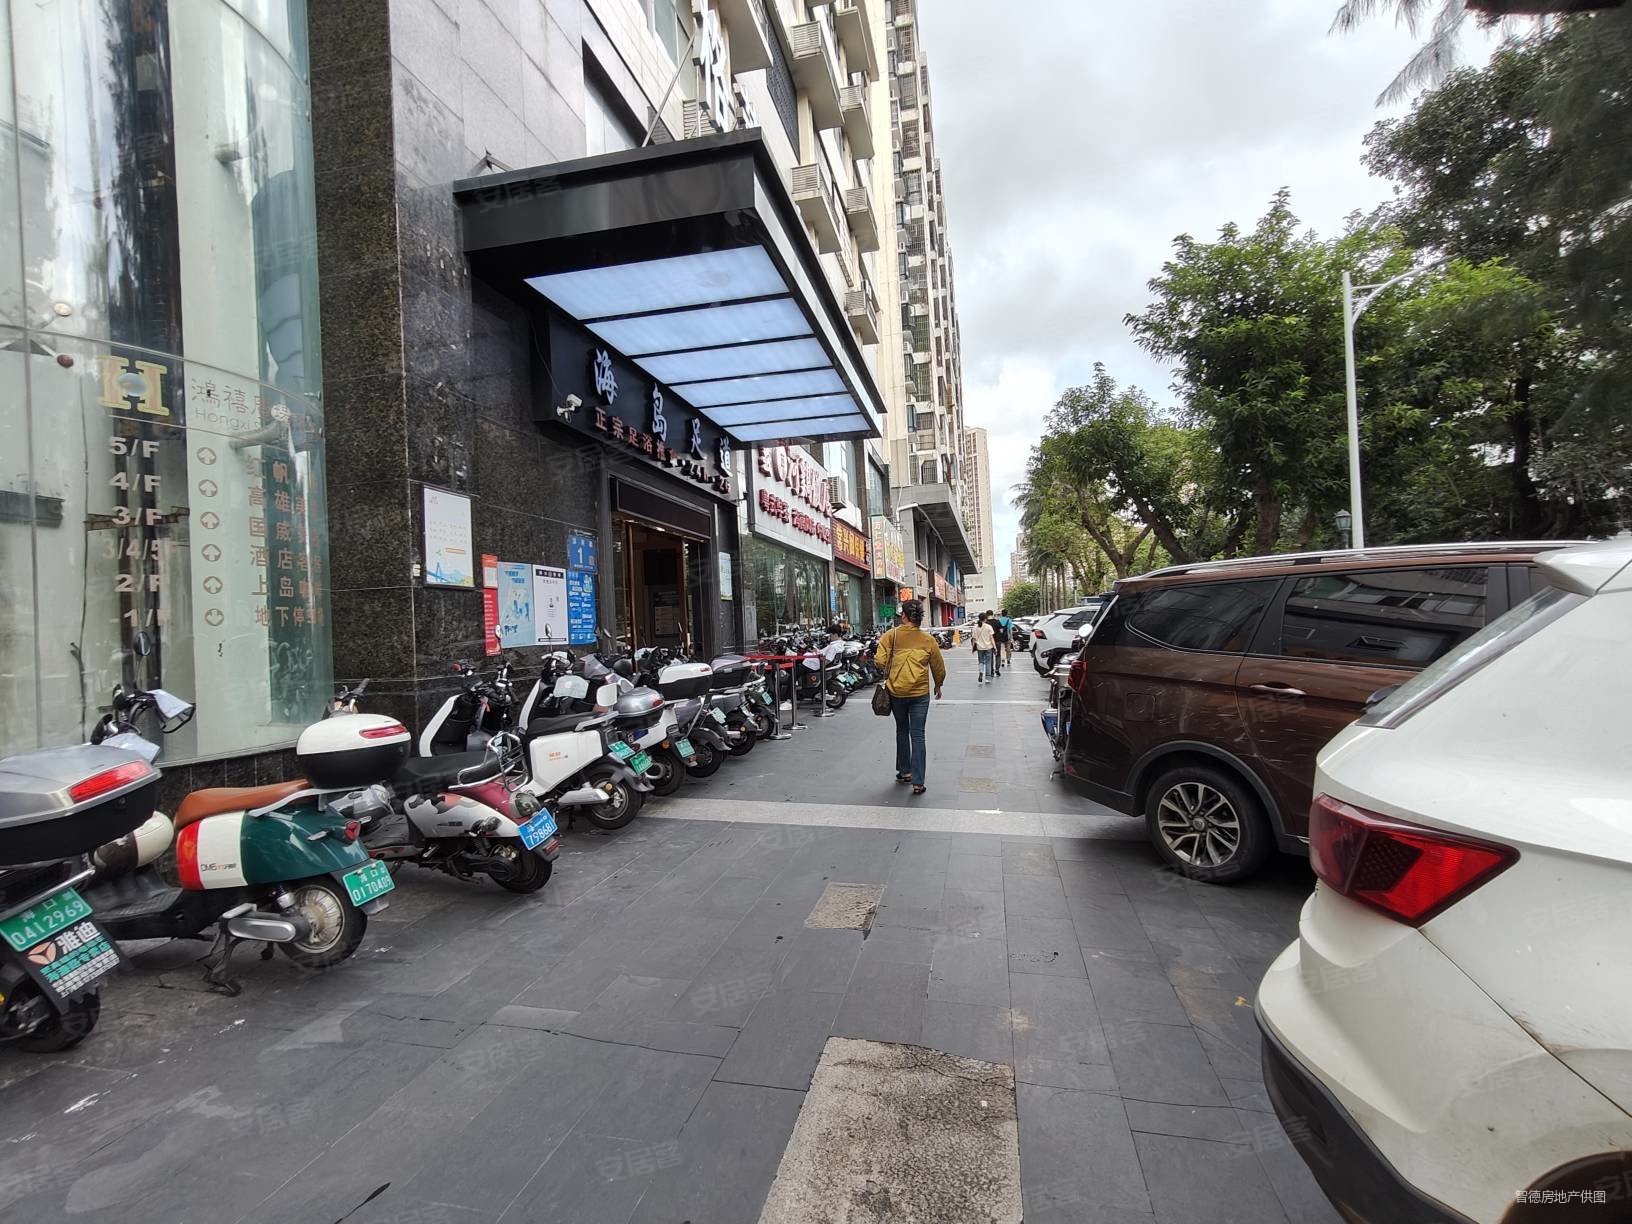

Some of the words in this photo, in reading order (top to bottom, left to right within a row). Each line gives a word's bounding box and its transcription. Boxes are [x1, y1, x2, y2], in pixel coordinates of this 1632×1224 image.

[108, 436, 160, 459] 5/F
[108, 471, 162, 492] 4/F
[111, 505, 163, 527] 3/F
[115, 573, 165, 593] 2/F
[10, 900, 84, 946] 0412969
[54, 921, 101, 955] 雅迪
